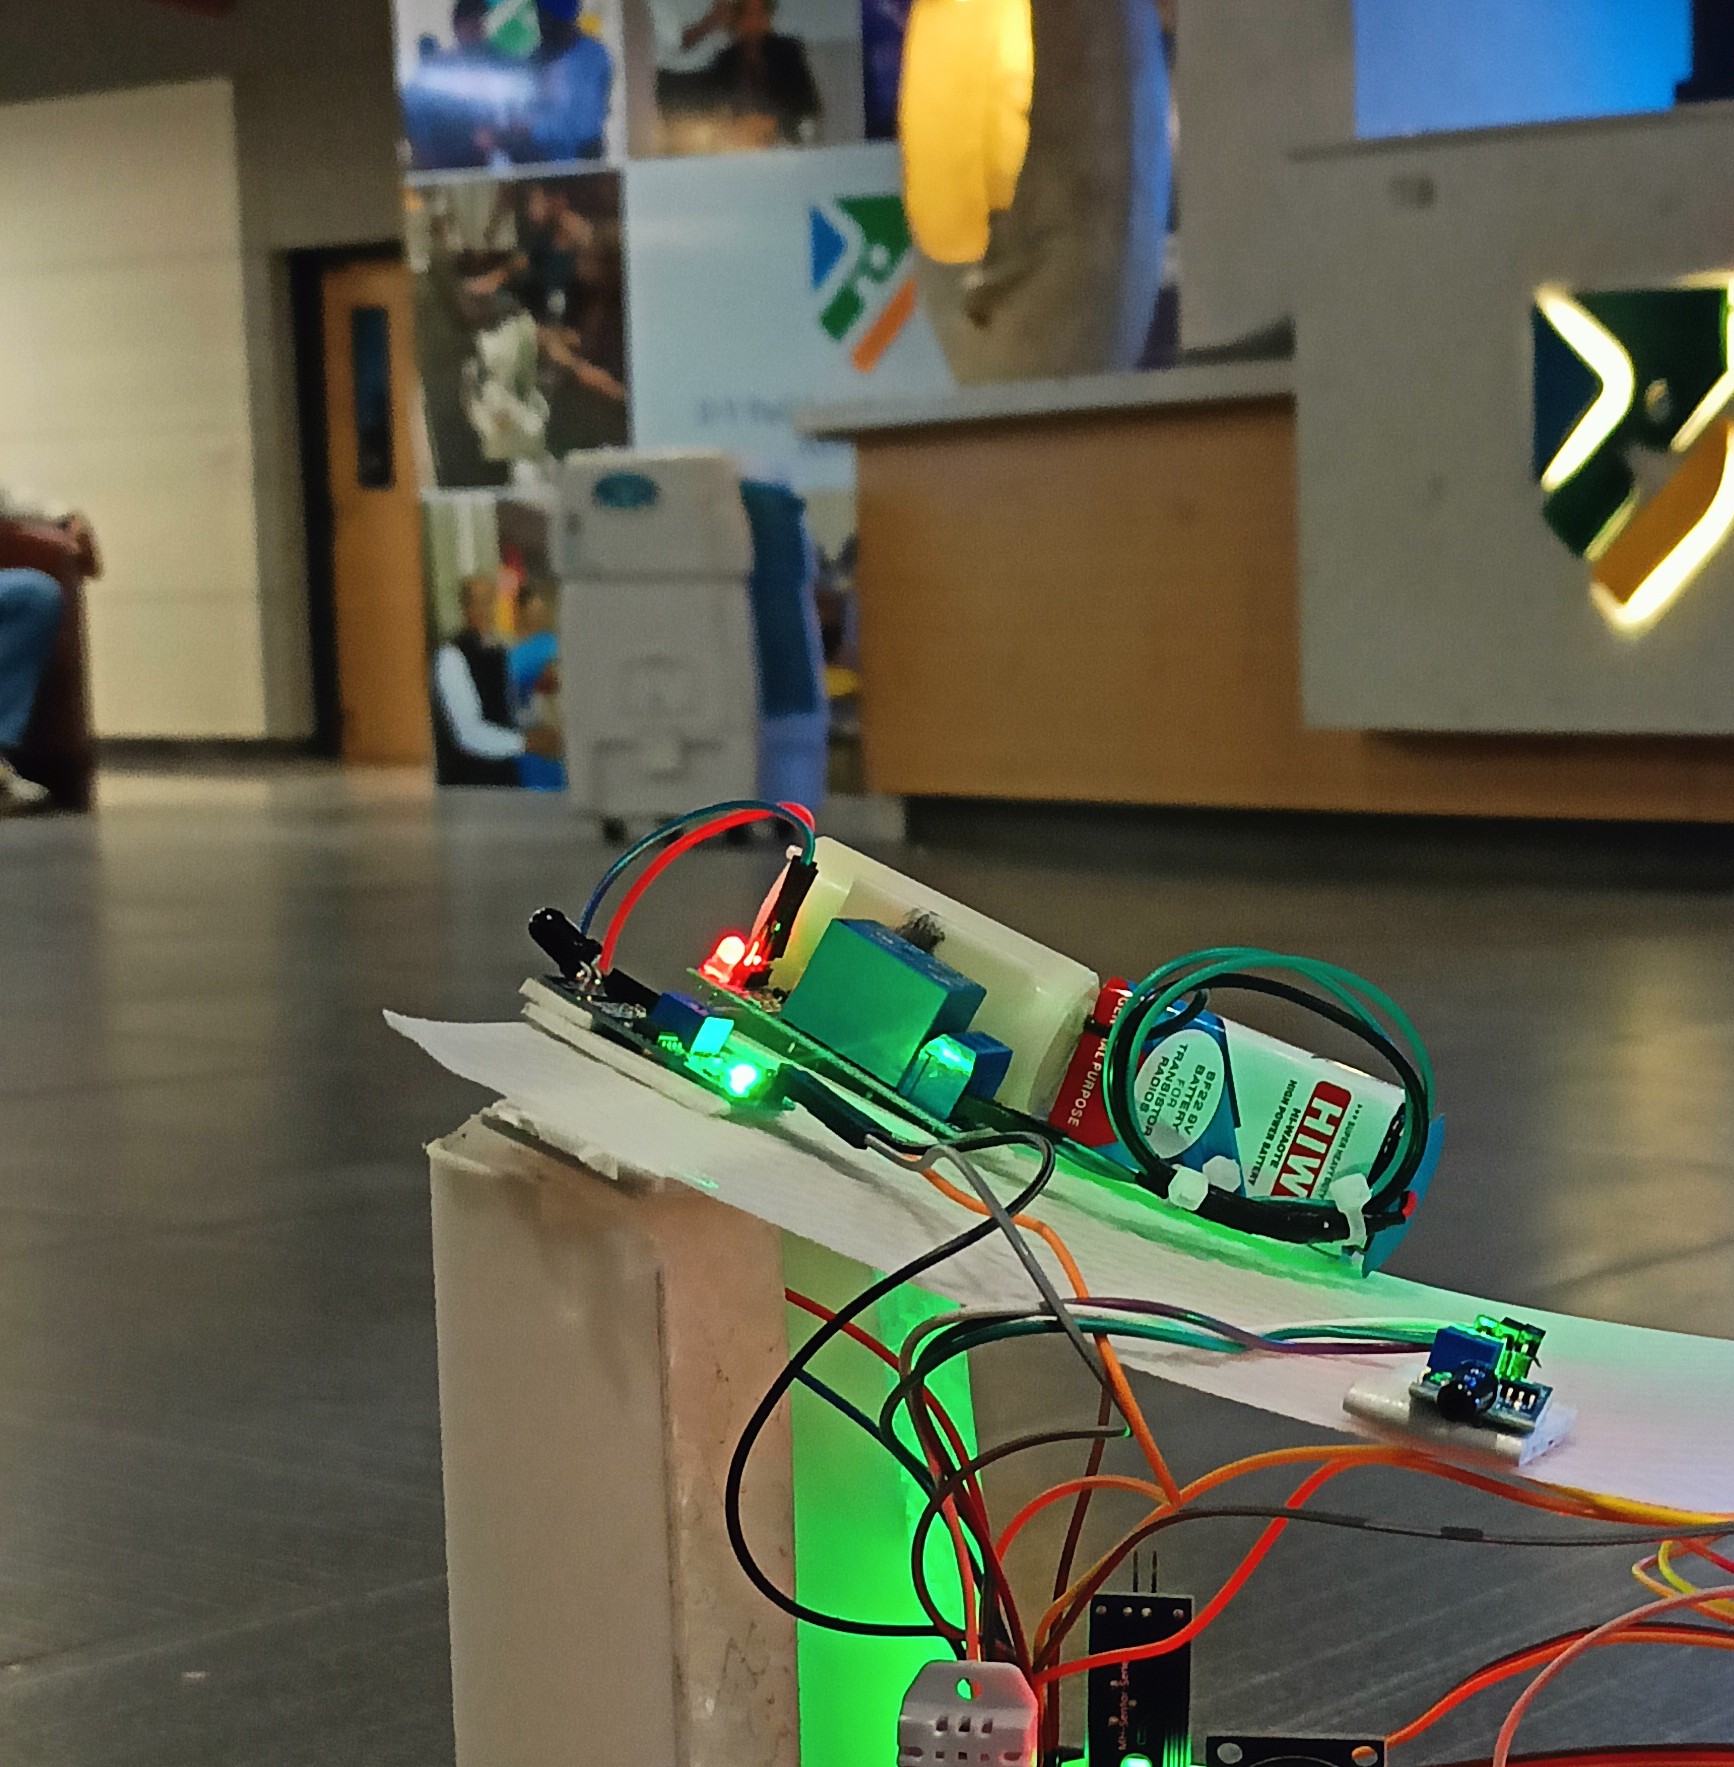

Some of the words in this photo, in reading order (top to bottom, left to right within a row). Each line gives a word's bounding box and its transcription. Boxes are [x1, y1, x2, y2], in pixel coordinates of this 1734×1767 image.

[1067, 1061, 1102, 1127] PURPOSE
[1139, 1056, 1169, 1113] RADIOS
[1144, 1043, 1188, 1136] TRANSISTOR
[1167, 1078, 1185, 1108] FOR
[1172, 1064, 1206, 1133] BATTERY
[1281, 1079, 1298, 1106] HIGH
[1265, 1105, 1286, 1141] POWER
[1279, 1096, 1343, 1198] HIW
[1248, 1141, 1271, 1186] BATTERY
